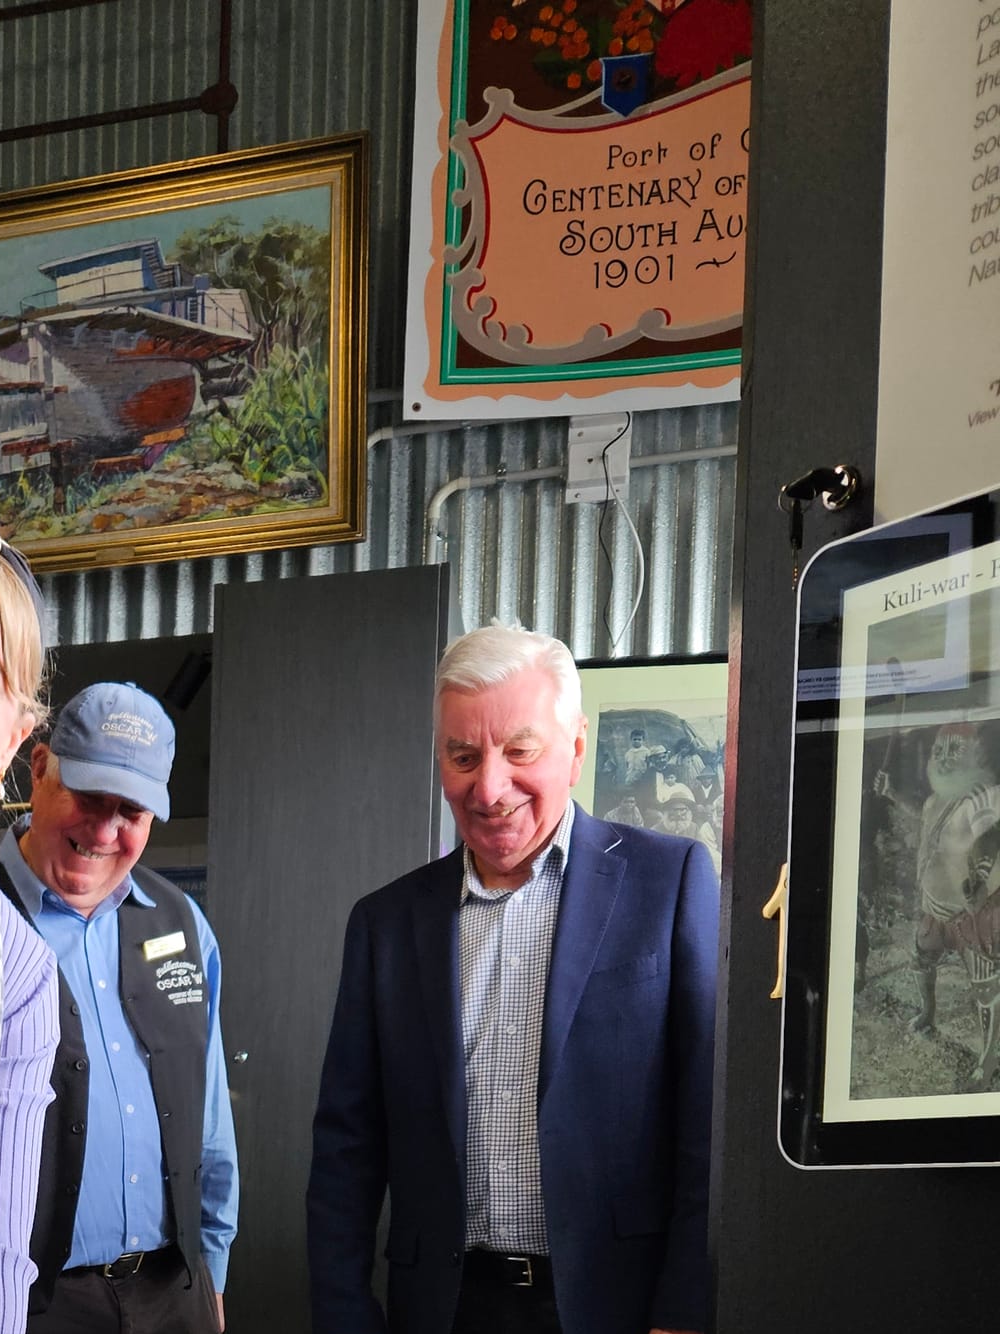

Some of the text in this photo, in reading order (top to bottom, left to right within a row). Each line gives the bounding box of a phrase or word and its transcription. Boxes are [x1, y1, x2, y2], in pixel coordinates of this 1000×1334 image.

[606, 142, 669, 170] Port
[689, 133, 722, 161] of
[715, 174, 746, 196] OF
[559, 208, 747, 256] SOUTH AU
[593, 254, 674, 289] 1901
[883, 572, 970, 612] Kuli-war
[156, 974, 193, 991] OSCAR
